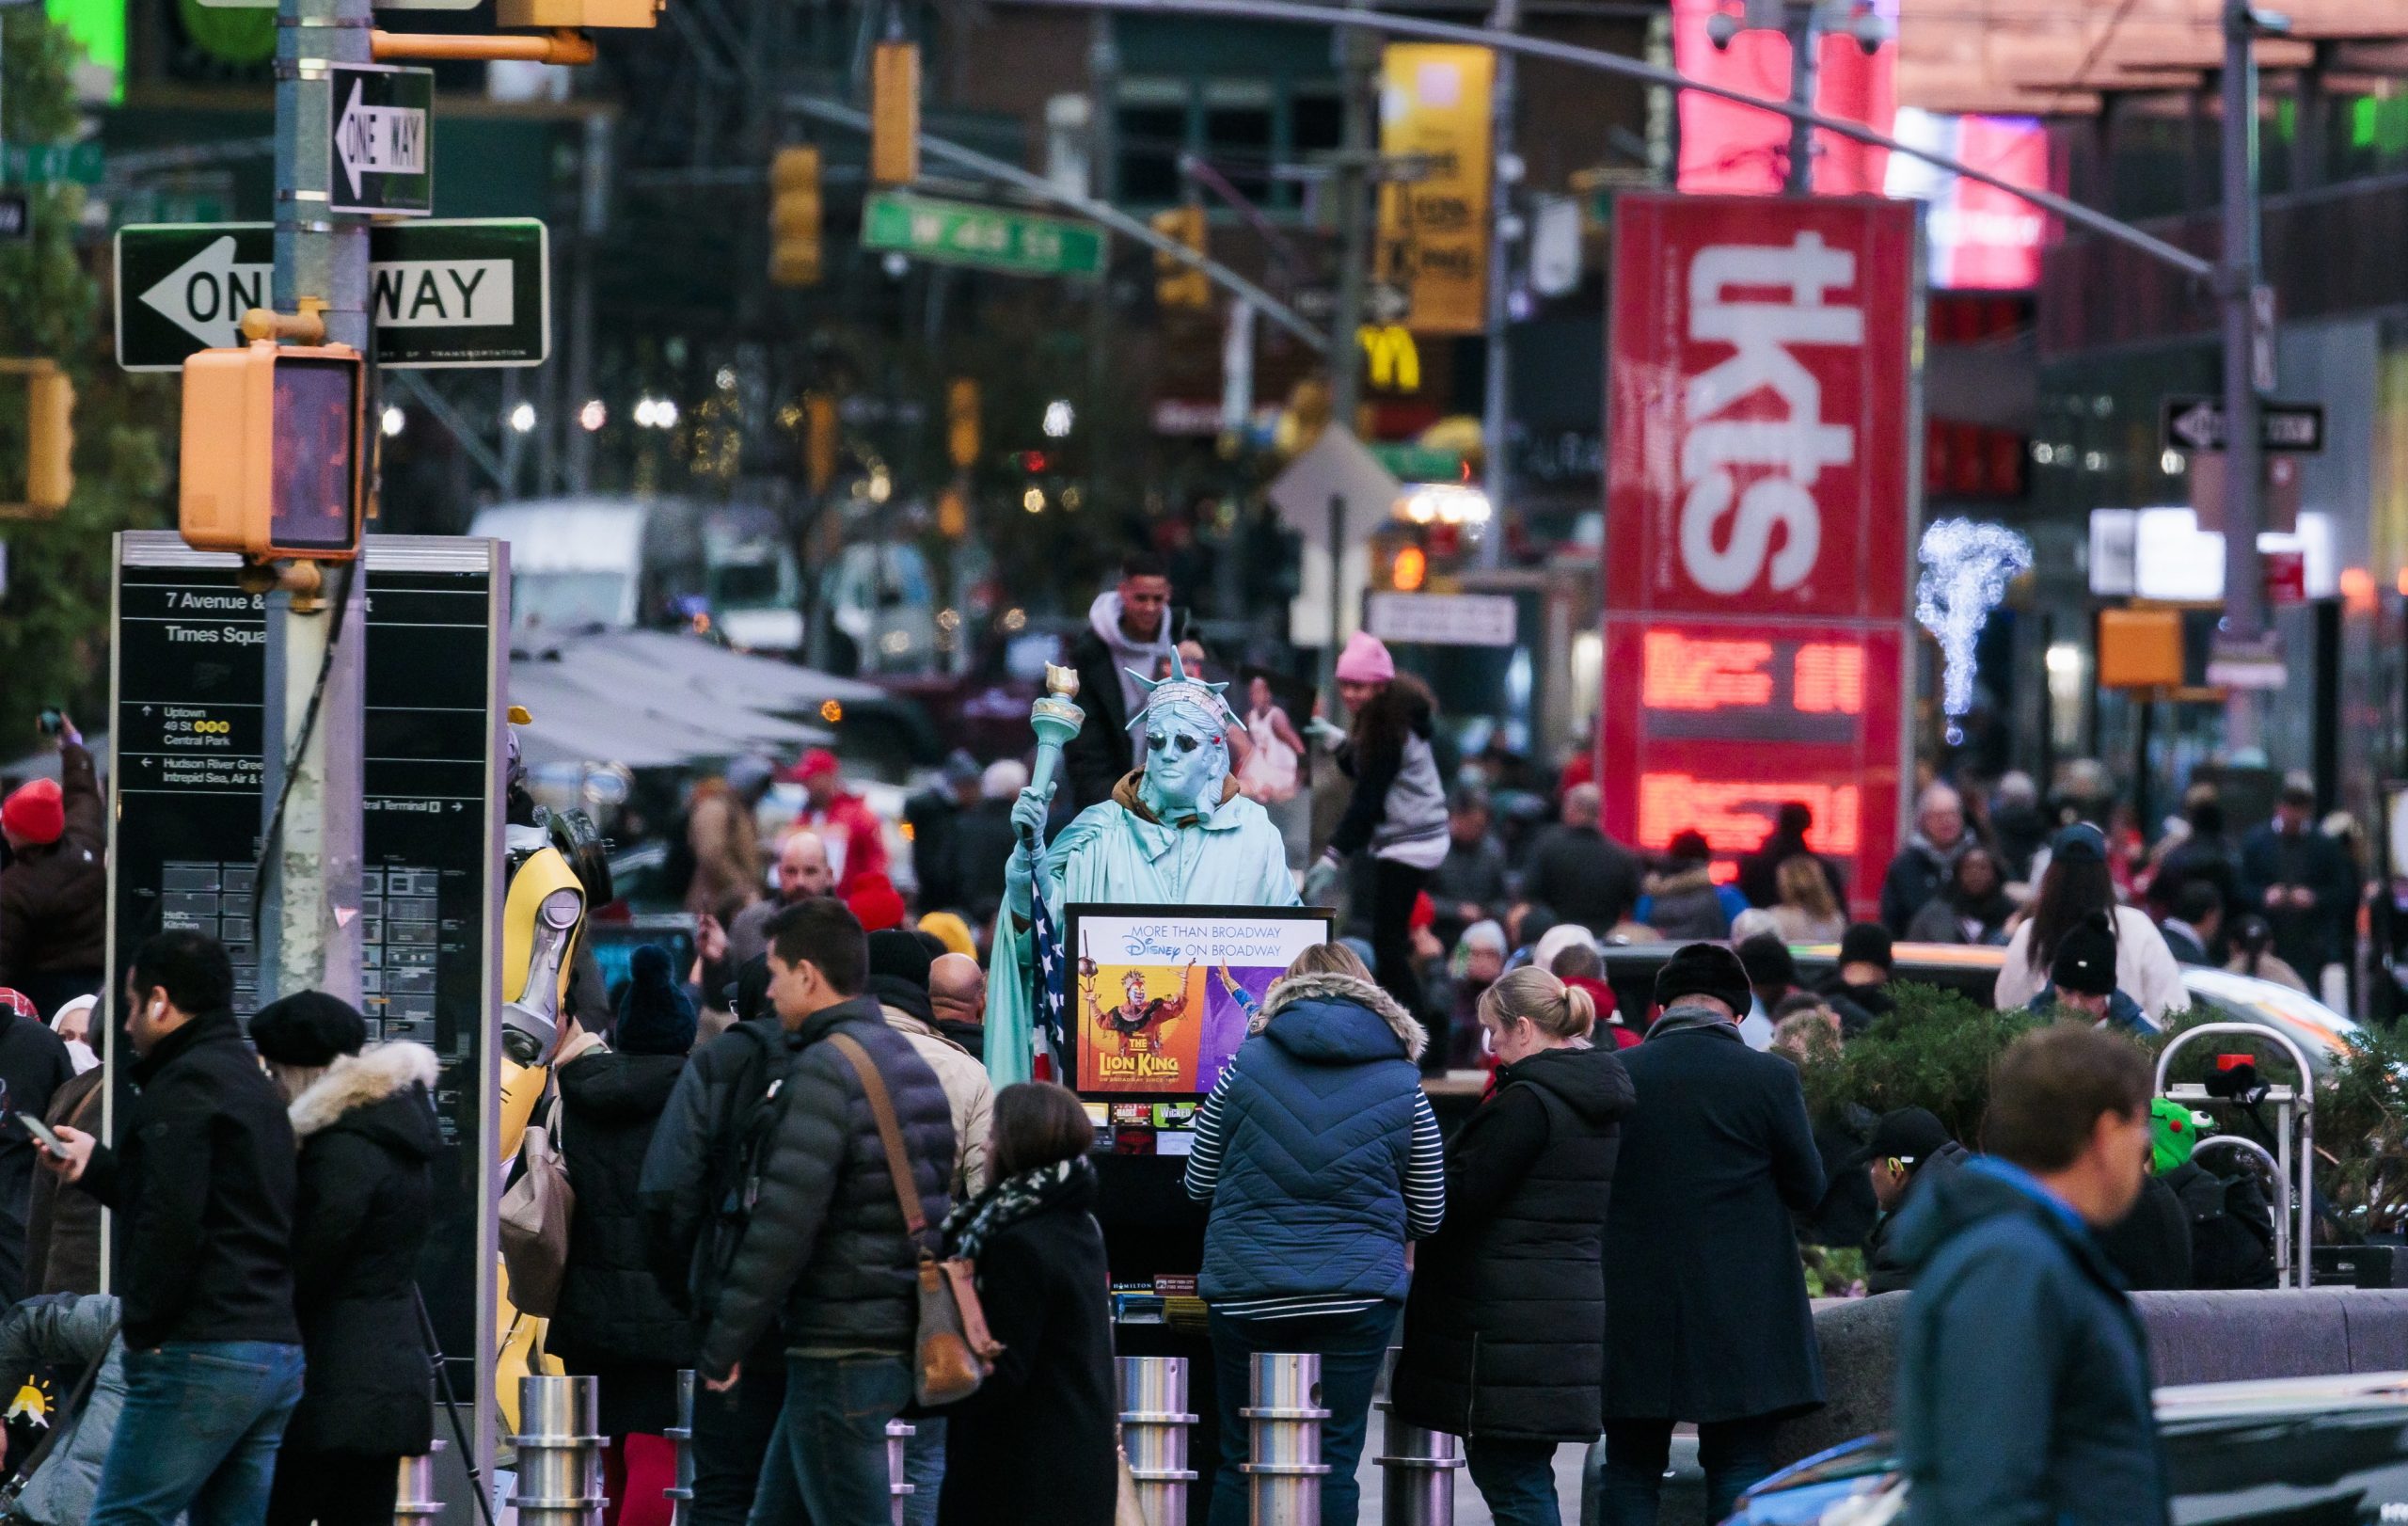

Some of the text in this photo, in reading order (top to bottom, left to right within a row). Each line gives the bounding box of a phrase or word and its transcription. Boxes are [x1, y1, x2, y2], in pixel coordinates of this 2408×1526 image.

[346, 112, 421, 167] ONE WAY
[186, 268, 487, 323] ON WAY
[1679, 230, 1865, 595] tkts
[166, 593, 266, 610] 7 Avenue &
[166, 626, 267, 644] Times Squa
[164, 707, 206, 718] Uptown
[180, 722, 192, 731] St
[164, 735, 230, 745] Central Park
[164, 758, 263, 770] Hudson River Gree
[163, 771, 204, 784] Intrepid
[230, 773, 246, 784] Air
[363, 800, 427, 811] tral Terminal
[163, 920, 199, 930] Kitchen
[1131, 925, 1282, 939] MORE THAN BROADWAY
[1185, 945, 1208, 957] ON
[1212, 945, 1282, 957] BROADWAY
[1129, 1039, 1148, 1048] THE
[1099, 1053, 1180, 1077] LION KING
